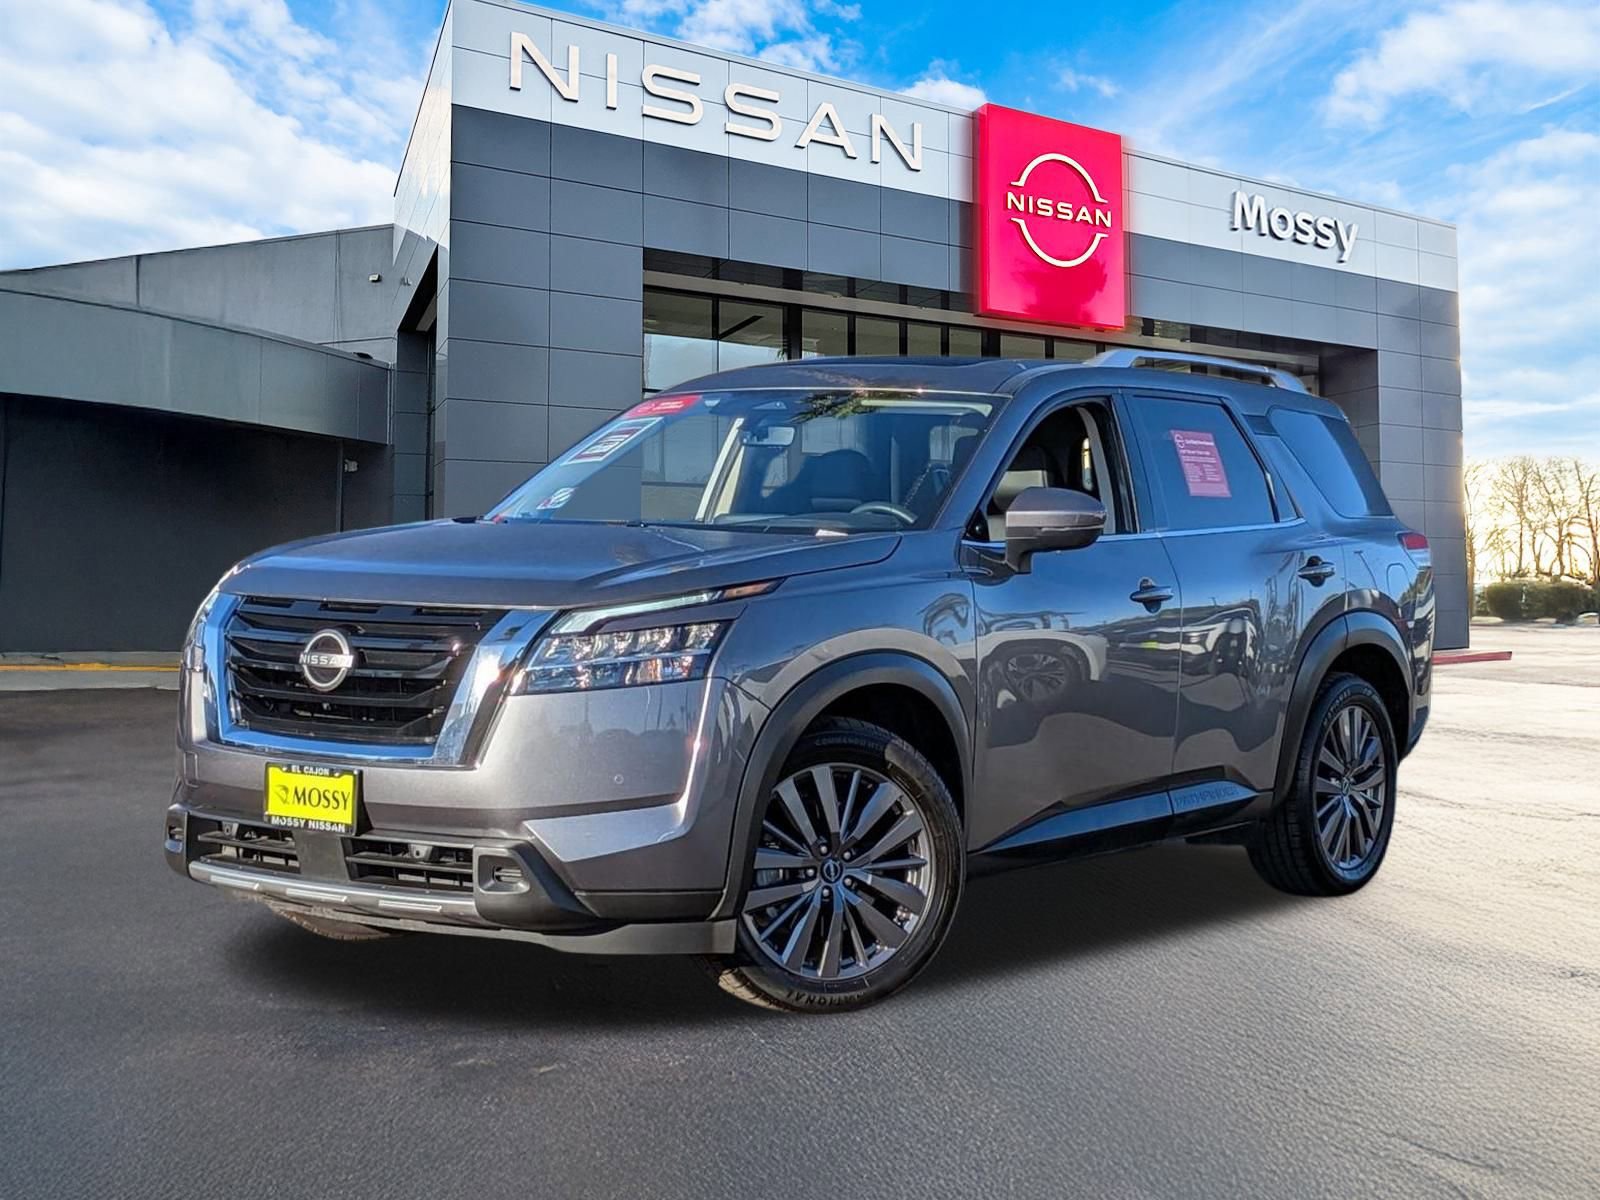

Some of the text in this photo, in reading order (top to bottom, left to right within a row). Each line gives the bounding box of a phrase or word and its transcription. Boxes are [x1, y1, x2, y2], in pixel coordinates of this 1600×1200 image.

[509, 31, 923, 172] NISSAN
[1006, 191, 1113, 229] NISSAN
[1230, 189, 1360, 263] Mossy
[299, 652, 354, 669] NISSAN
[290, 764, 330, 776] EL CAJON
[292, 786, 351, 811] MOSSY
[270, 815, 346, 833] MOSSY NISSAN
